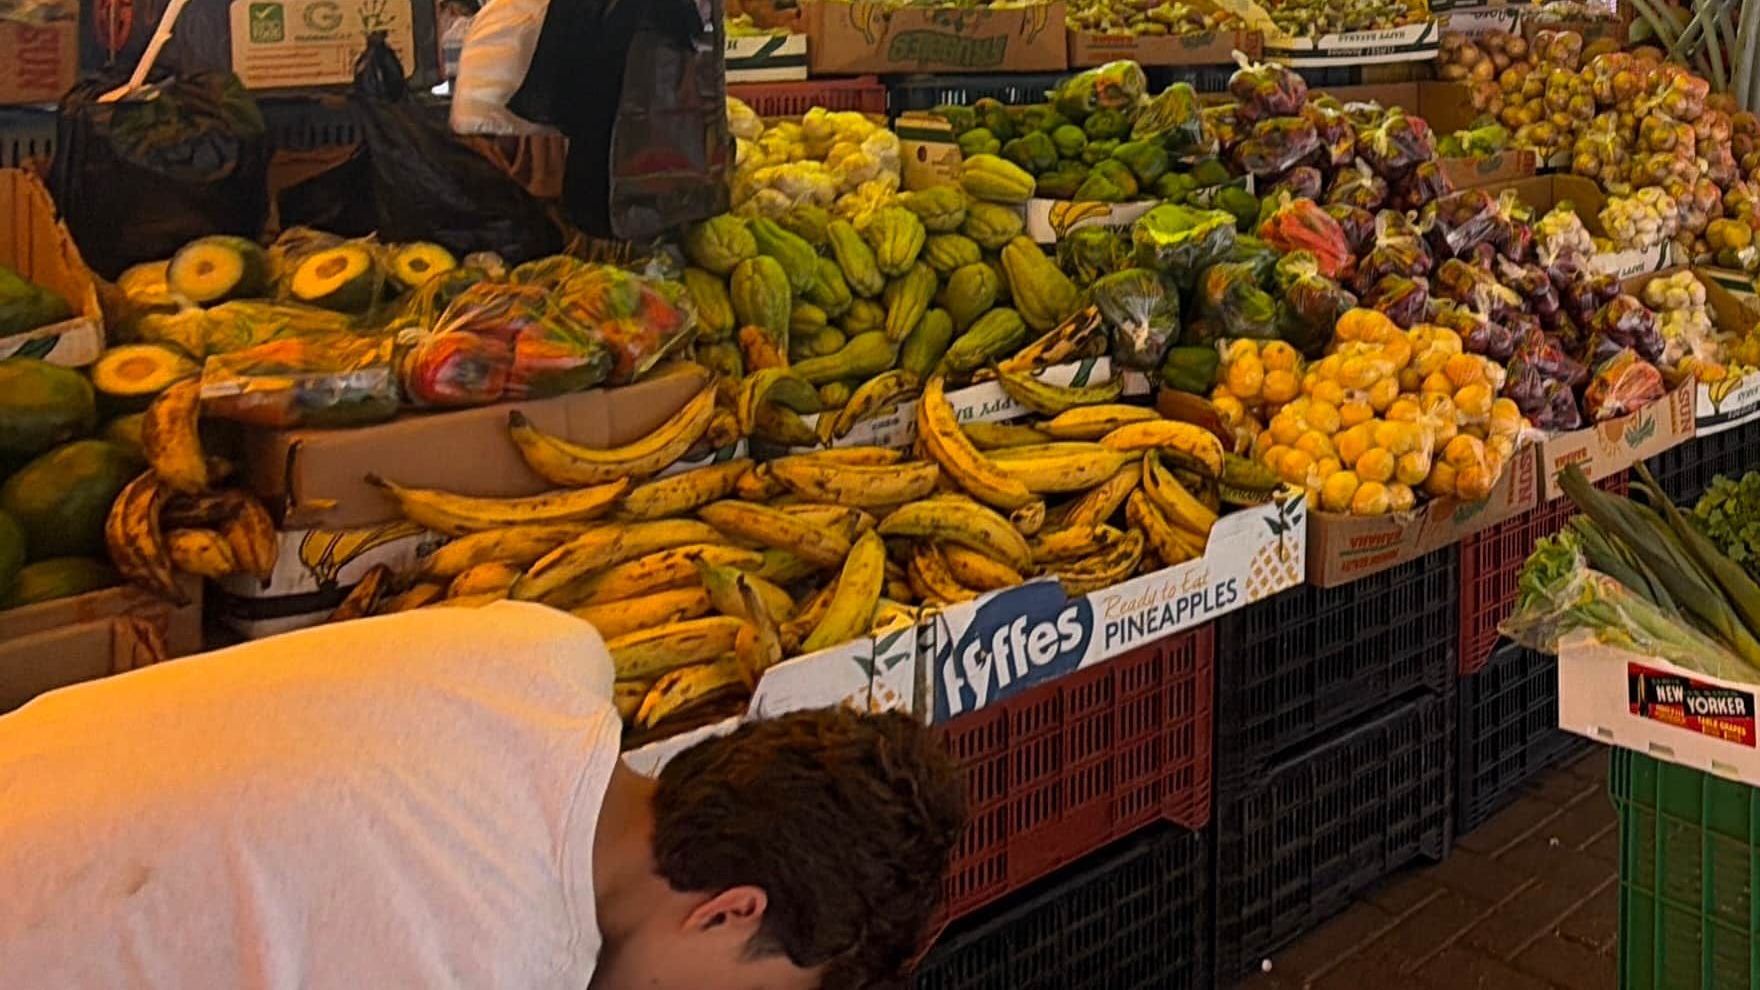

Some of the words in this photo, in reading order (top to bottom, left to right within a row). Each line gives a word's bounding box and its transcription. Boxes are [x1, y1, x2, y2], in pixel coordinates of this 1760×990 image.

[16, 25, 61, 91] SUN
[978, 398, 1021, 417] APPY
[1678, 389, 1692, 434] SUN
[1518, 454, 1533, 505] SUN
[1103, 590, 1156, 620] Ready
[1104, 577, 1238, 650] PINEAPPLES
[942, 604, 1084, 718] fyffes
[1655, 683, 1684, 704] NEW
[1686, 695, 1746, 716] YORKER
